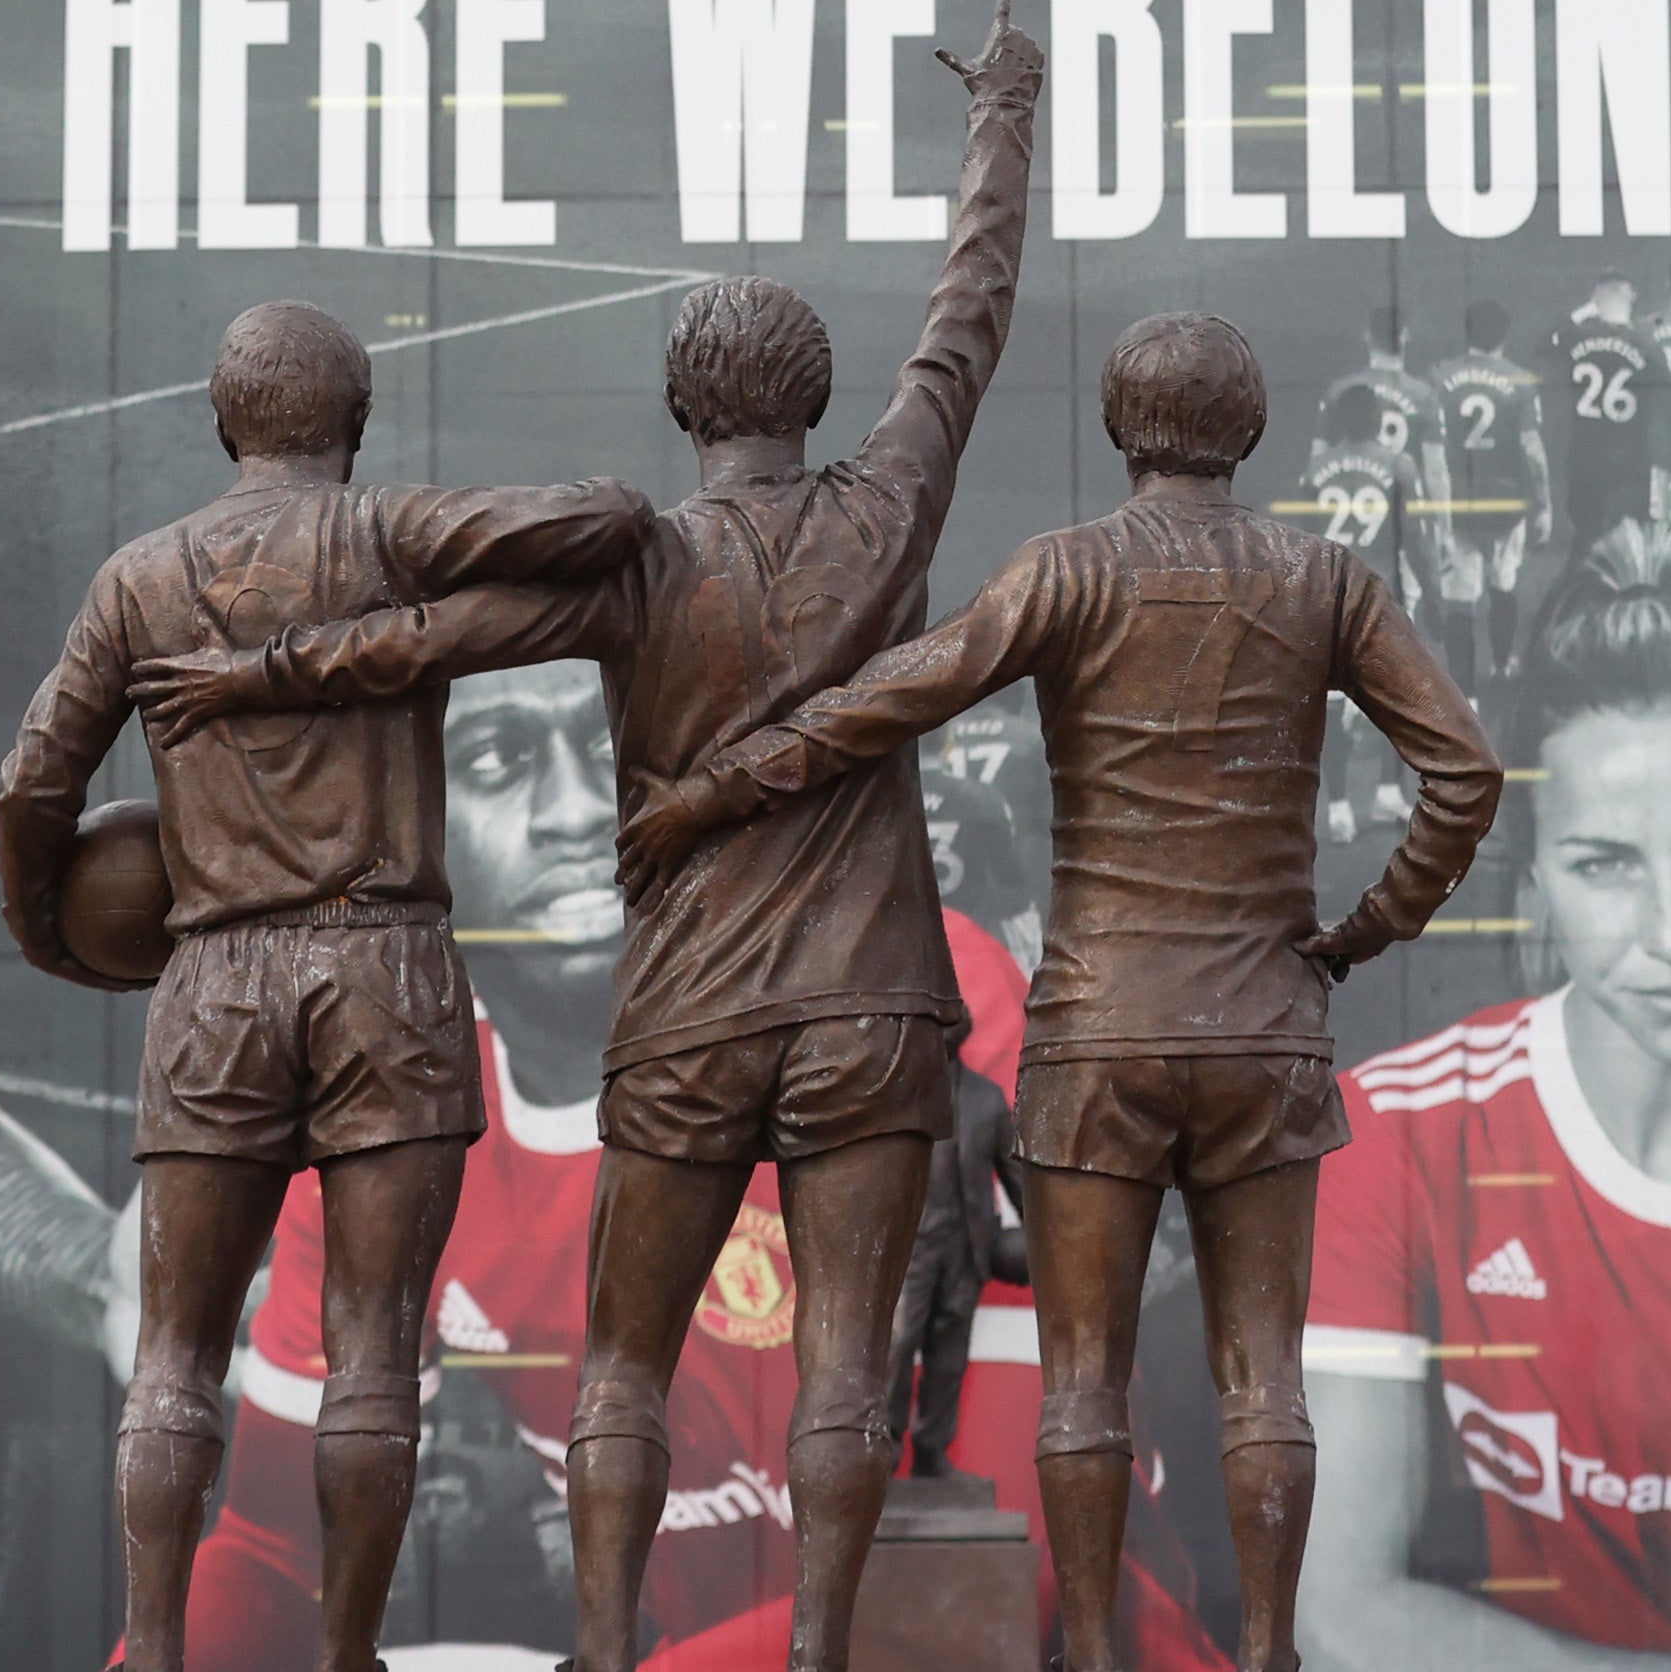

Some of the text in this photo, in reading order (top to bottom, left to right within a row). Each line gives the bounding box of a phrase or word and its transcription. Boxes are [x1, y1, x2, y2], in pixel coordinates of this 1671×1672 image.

[1460, 393, 1496, 449] 2
[1572, 363, 1637, 423] 26
[1318, 485, 1389, 547] 29
